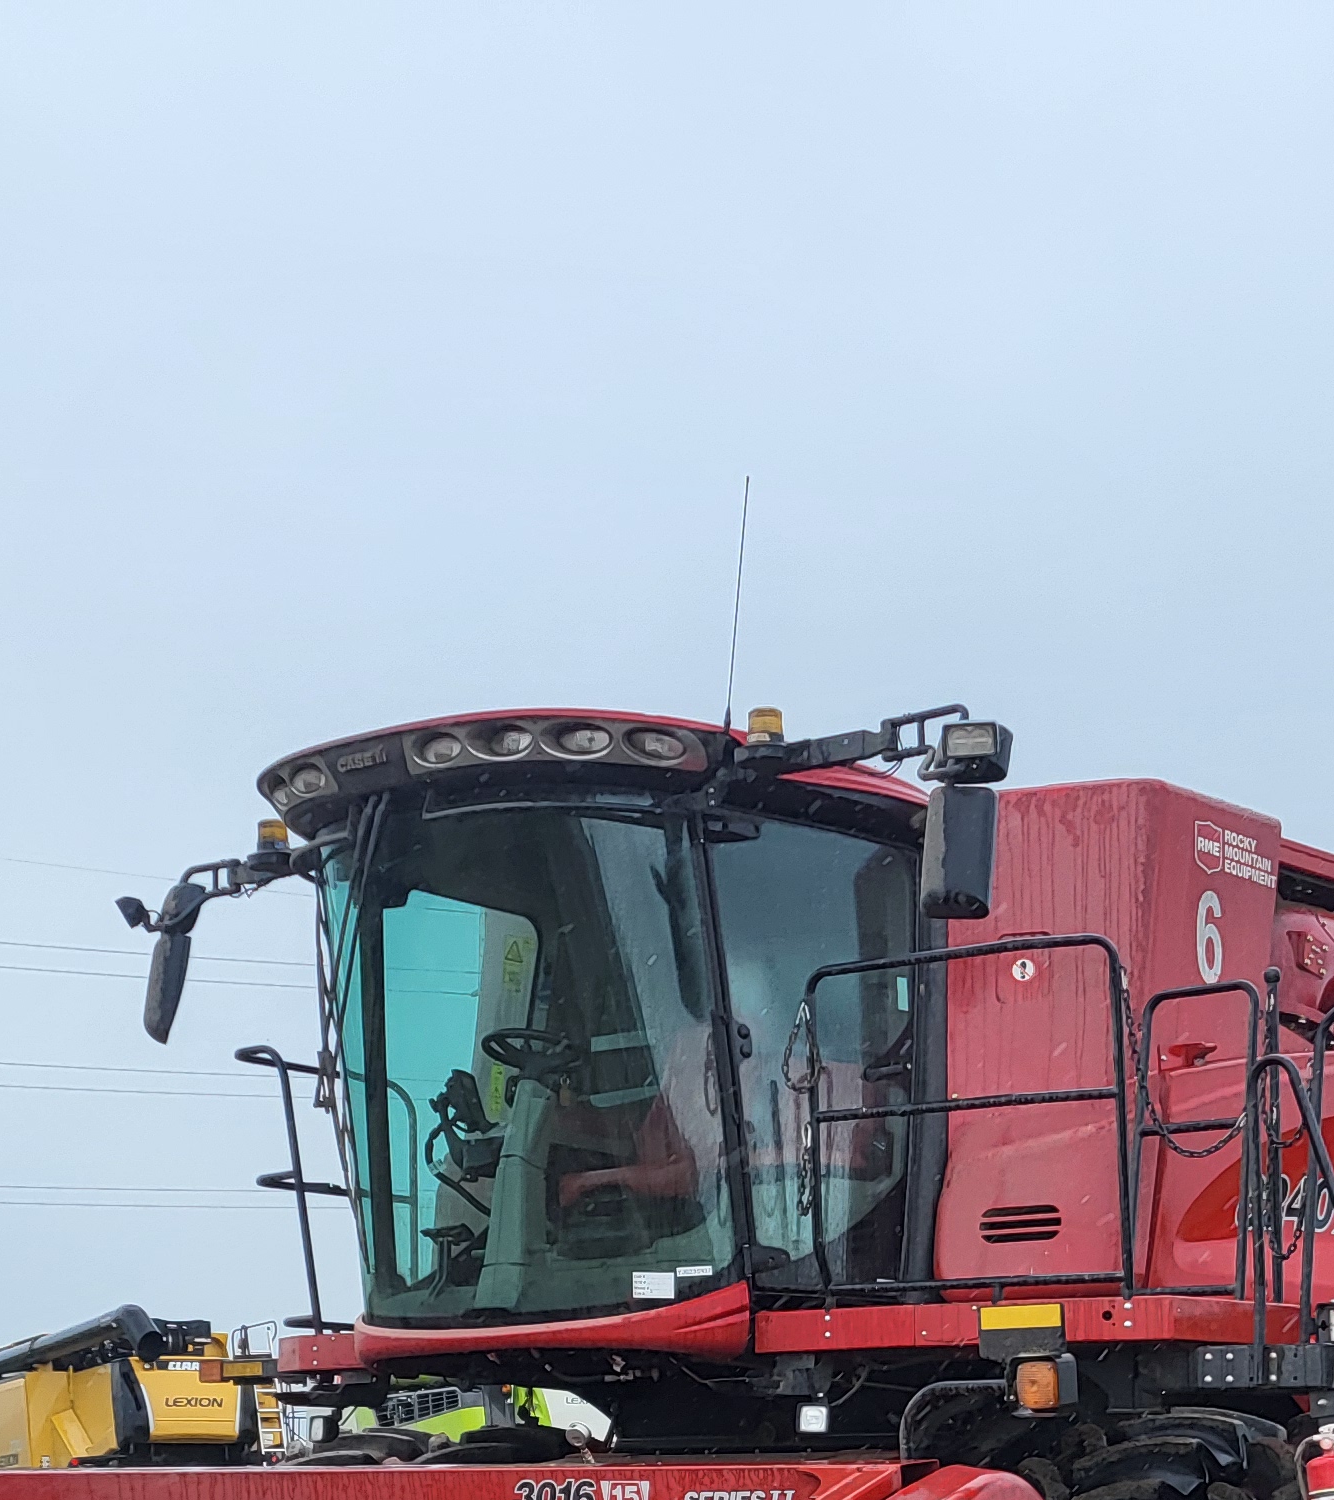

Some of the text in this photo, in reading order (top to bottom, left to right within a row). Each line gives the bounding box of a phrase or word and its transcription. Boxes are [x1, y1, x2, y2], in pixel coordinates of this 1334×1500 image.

[1197, 837, 1220, 857] RME
[1224, 830, 1257, 852] ROCKY
[1224, 845, 1271, 872] MOUNTAIN
[1224, 860, 1276, 888] EQUIPMENT
[1197, 891, 1222, 984] 6
[168, 1362, 199, 1370] CLAA
[165, 1397, 223, 1408] LEXION
